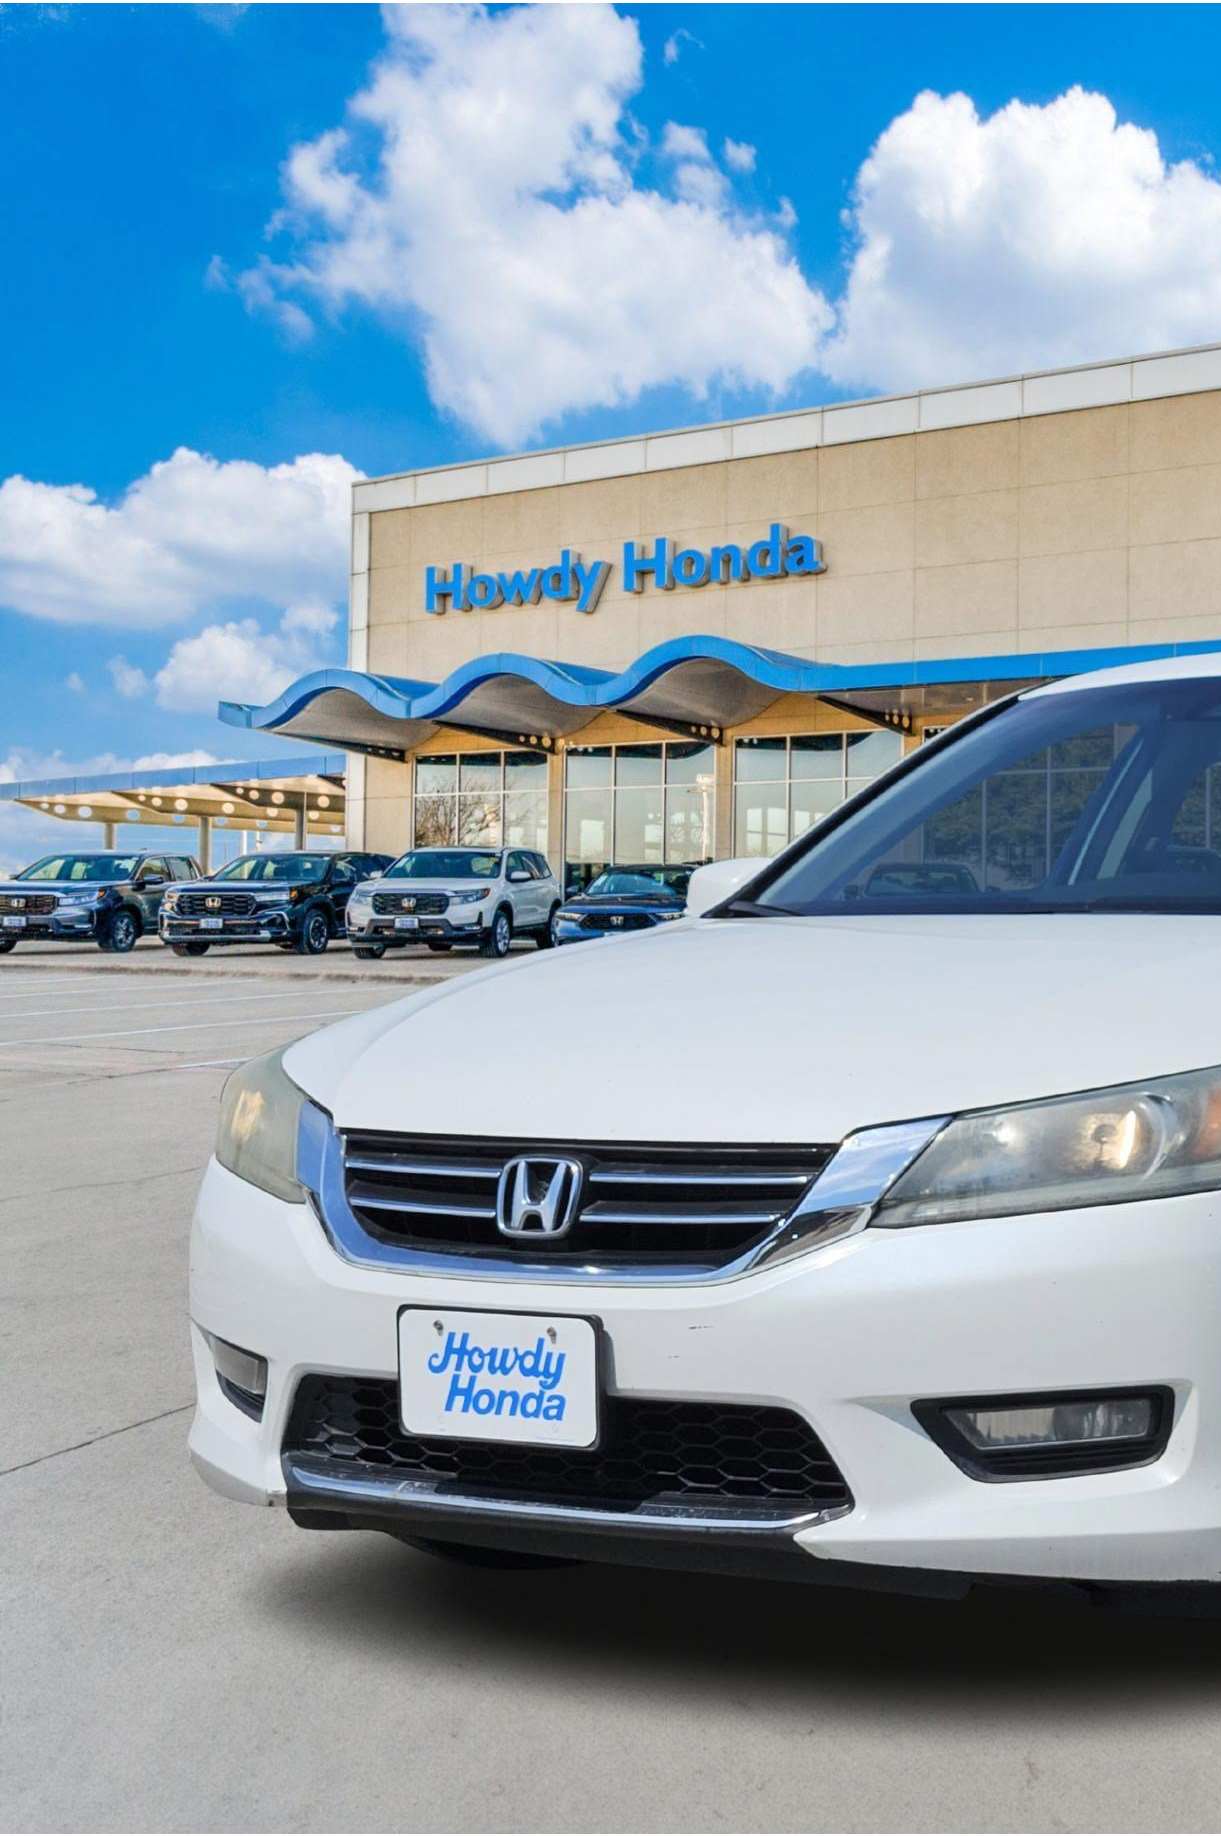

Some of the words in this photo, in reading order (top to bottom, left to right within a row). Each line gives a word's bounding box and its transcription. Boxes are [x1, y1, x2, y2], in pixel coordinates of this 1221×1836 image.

[425, 549, 611, 614] Howdy
[623, 523, 827, 593] Honda
[427, 1331, 567, 1390] Howdy
[444, 1373, 567, 1422] Honda
